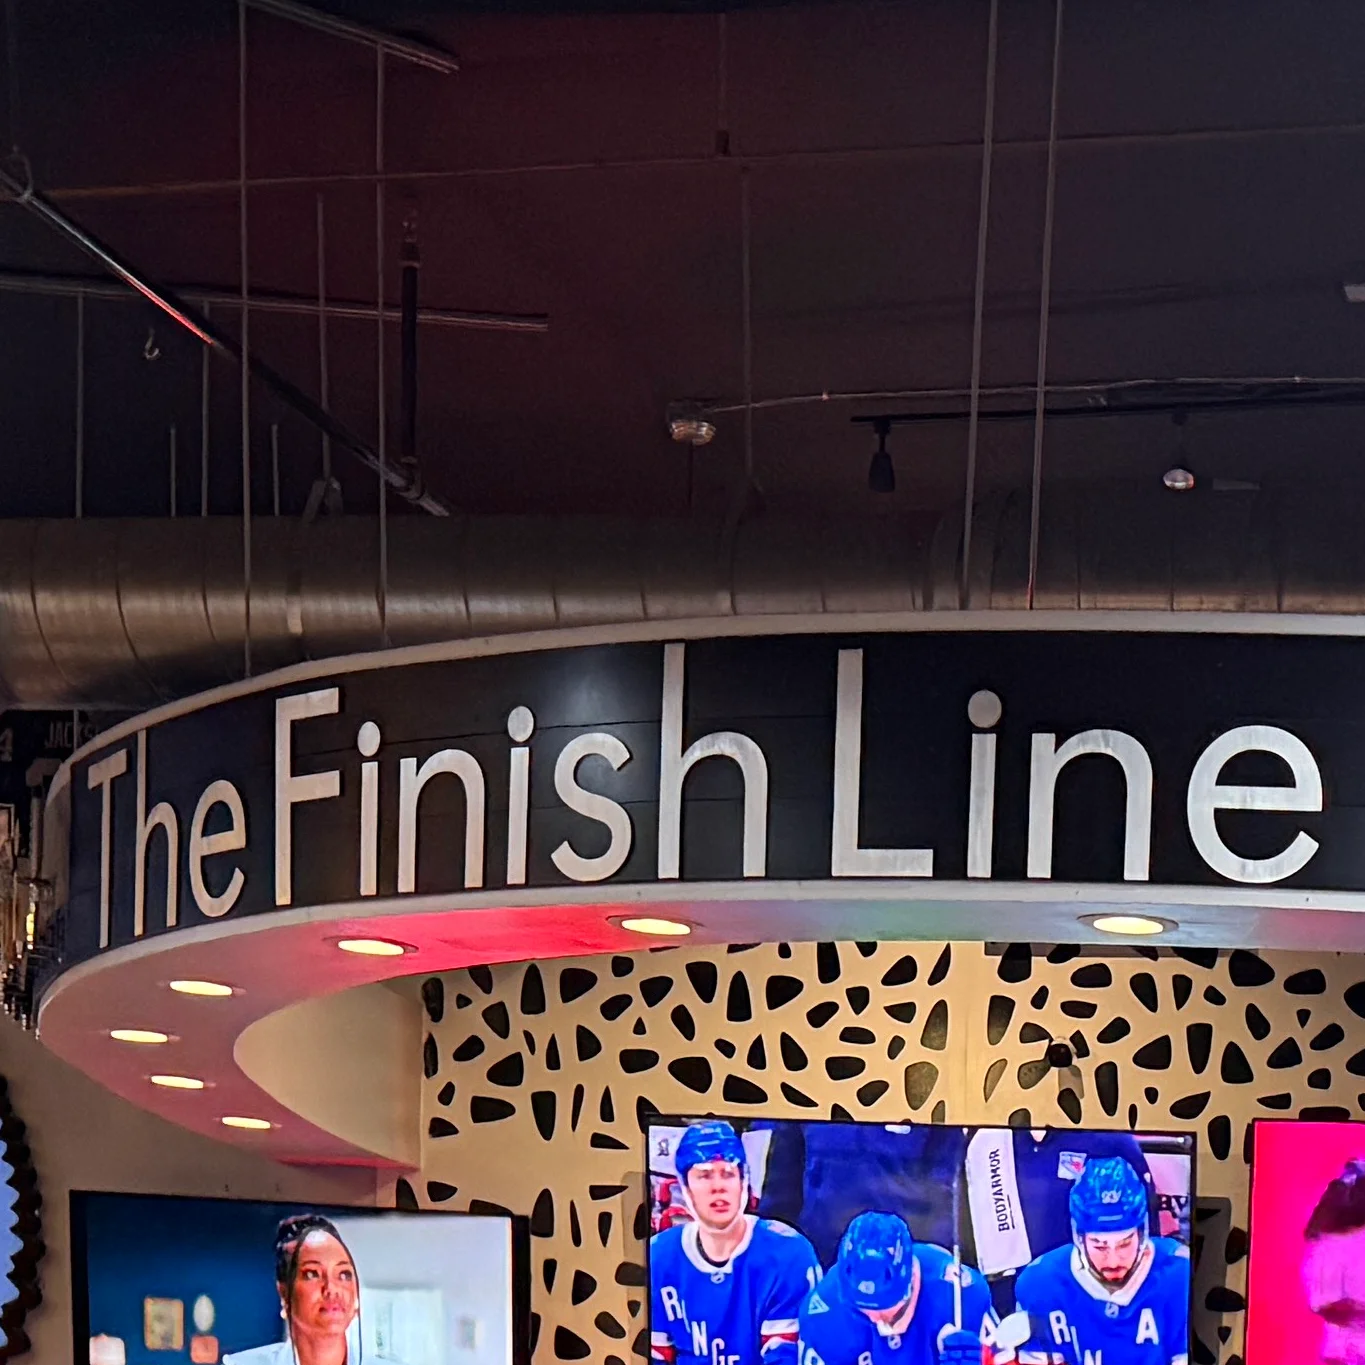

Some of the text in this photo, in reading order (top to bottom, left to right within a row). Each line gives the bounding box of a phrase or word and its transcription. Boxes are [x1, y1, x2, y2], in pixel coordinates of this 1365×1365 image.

[87, 643, 1324, 949] The Finish Line
[989, 1148, 1010, 1232] BODYARMOR
[1136, 1308, 1160, 1345] A
